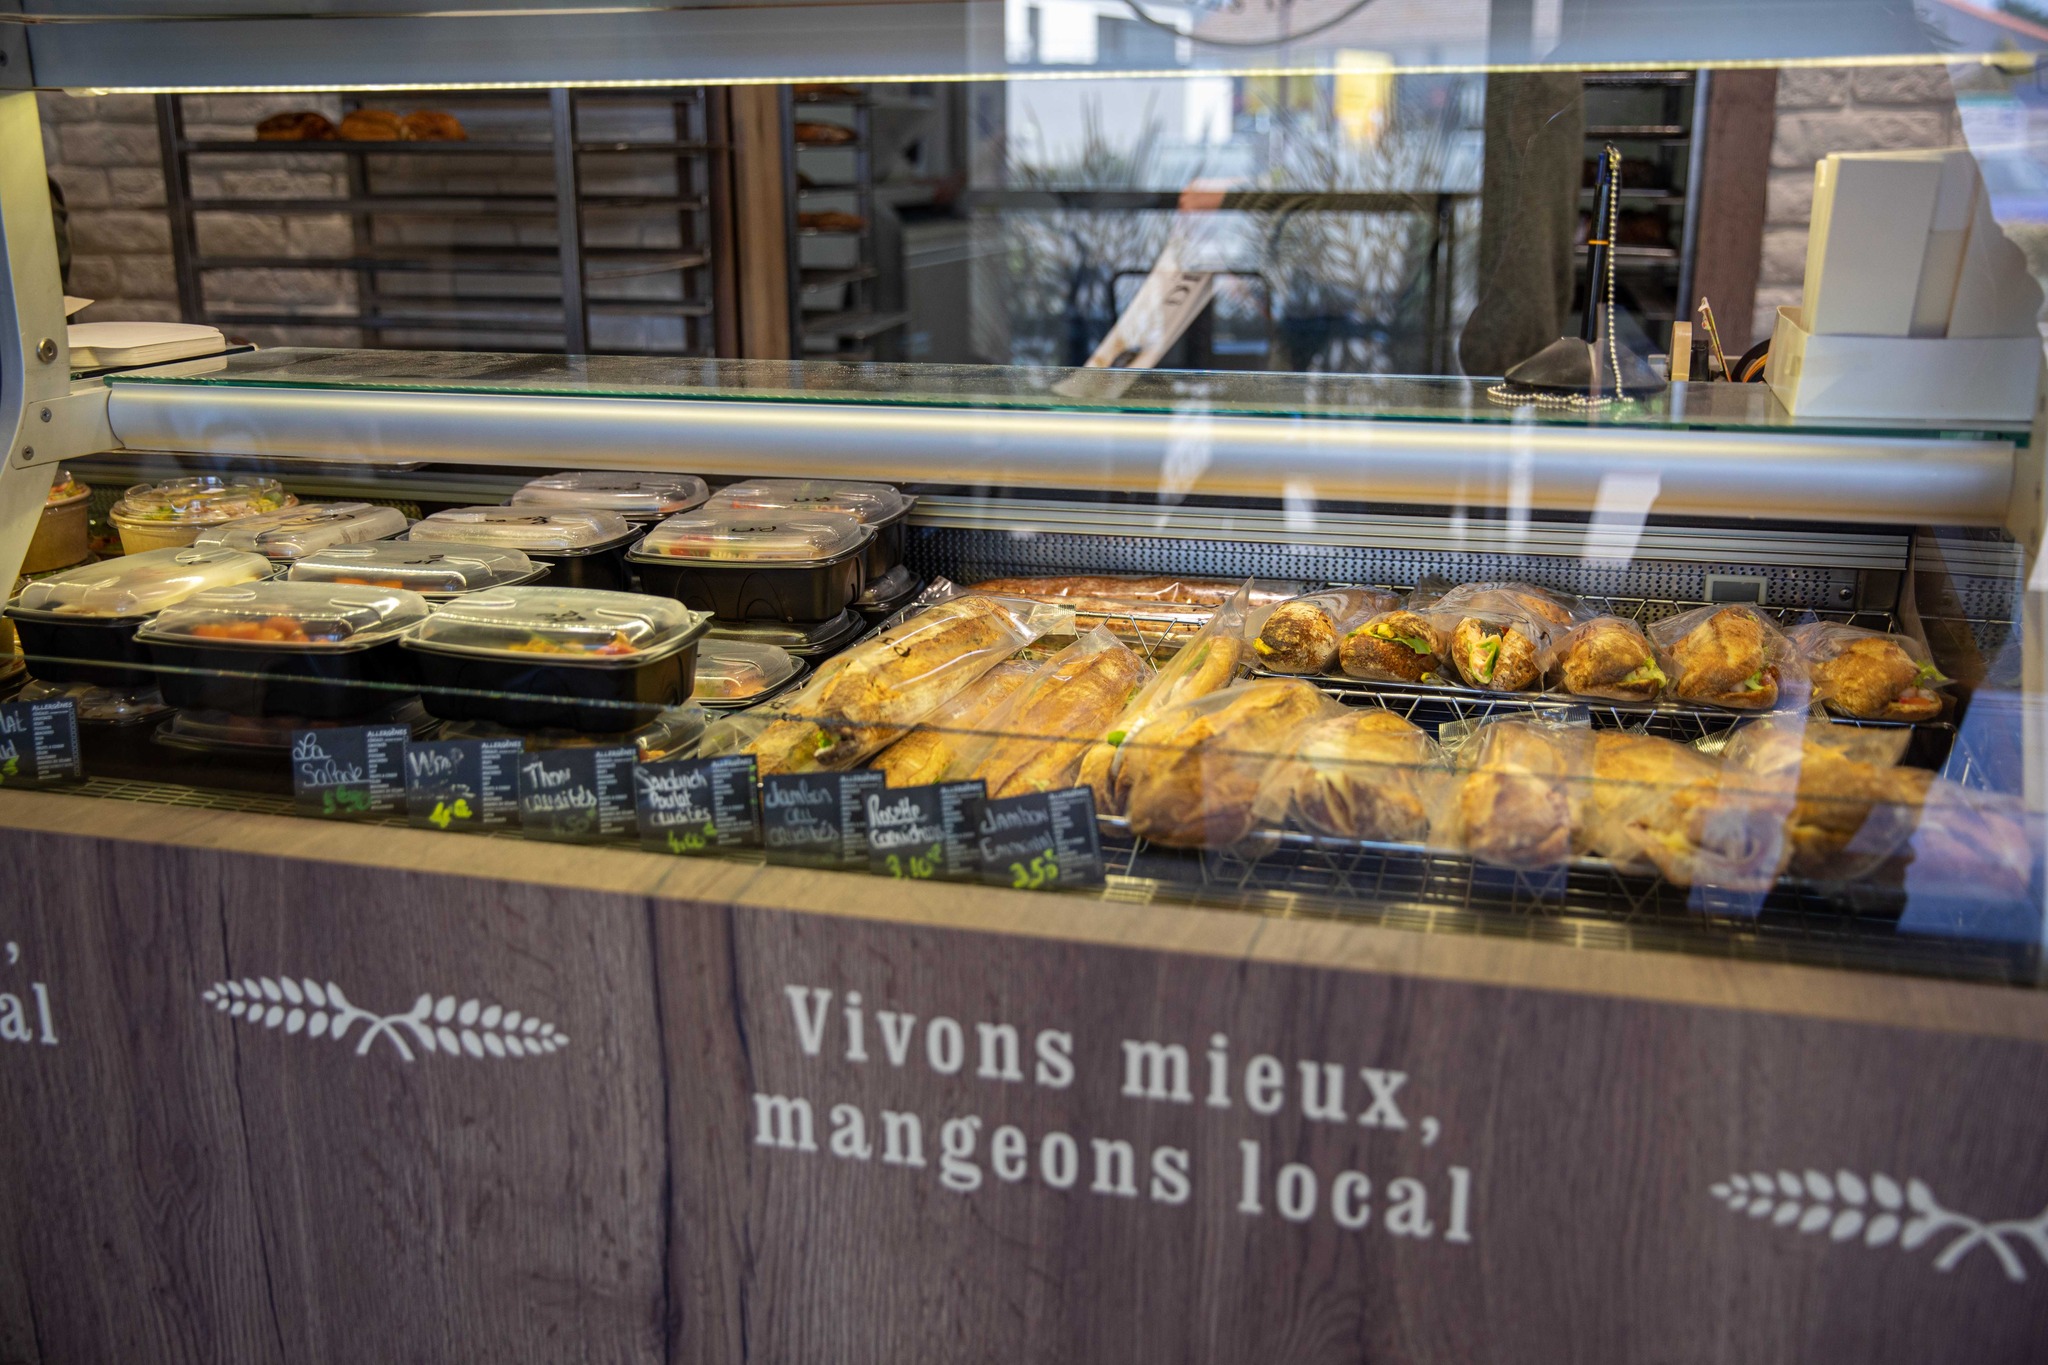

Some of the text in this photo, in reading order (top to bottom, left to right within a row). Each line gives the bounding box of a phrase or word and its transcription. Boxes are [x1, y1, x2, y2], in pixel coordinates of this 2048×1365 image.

[293, 732, 332, 761] La
[302, 759, 371, 788] Salade
[784, 984, 1442, 1148] Vivons mieux,
[752, 1091, 1473, 1246] mangeons local
